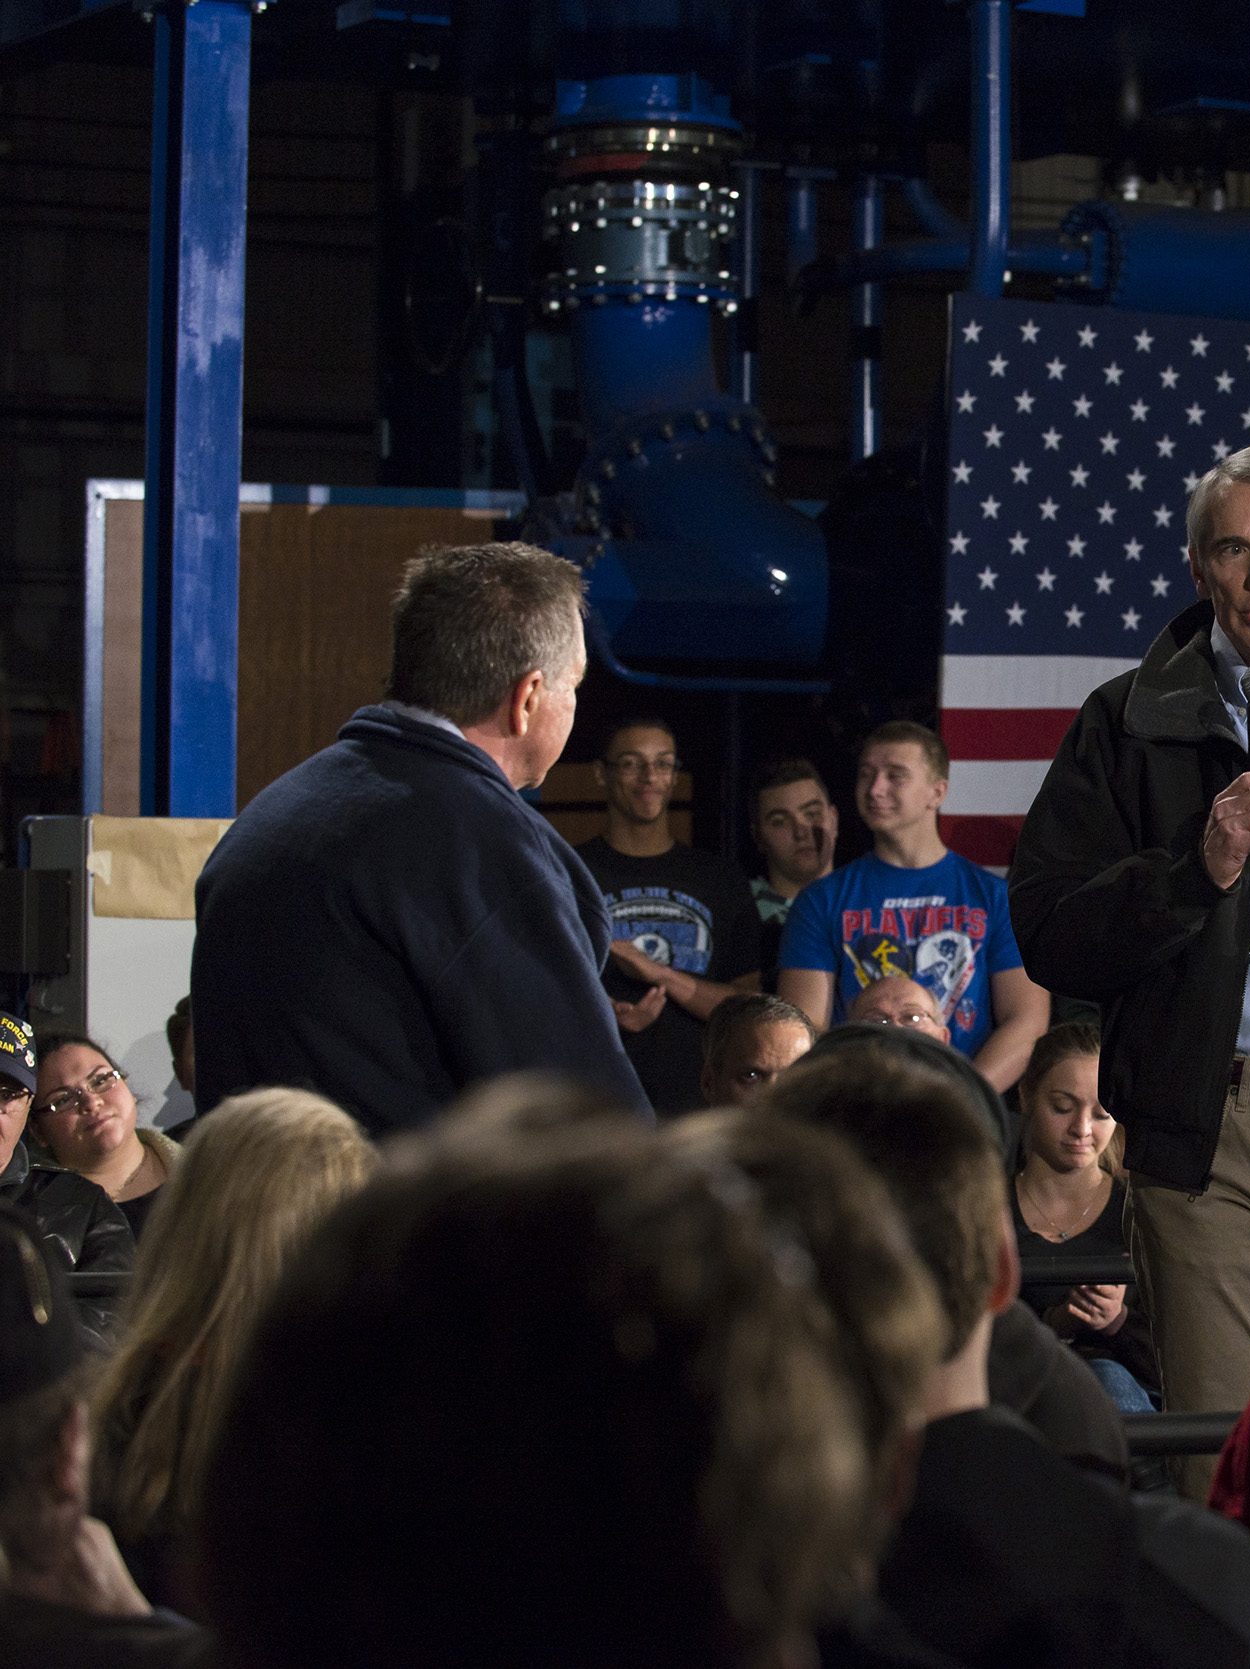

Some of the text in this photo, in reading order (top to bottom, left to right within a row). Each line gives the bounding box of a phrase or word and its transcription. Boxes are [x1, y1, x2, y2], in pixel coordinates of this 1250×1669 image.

[842, 905, 988, 941] PLAYOFFS
[871, 938, 899, 966] K
[1, 1017, 29, 1045] FORCE
